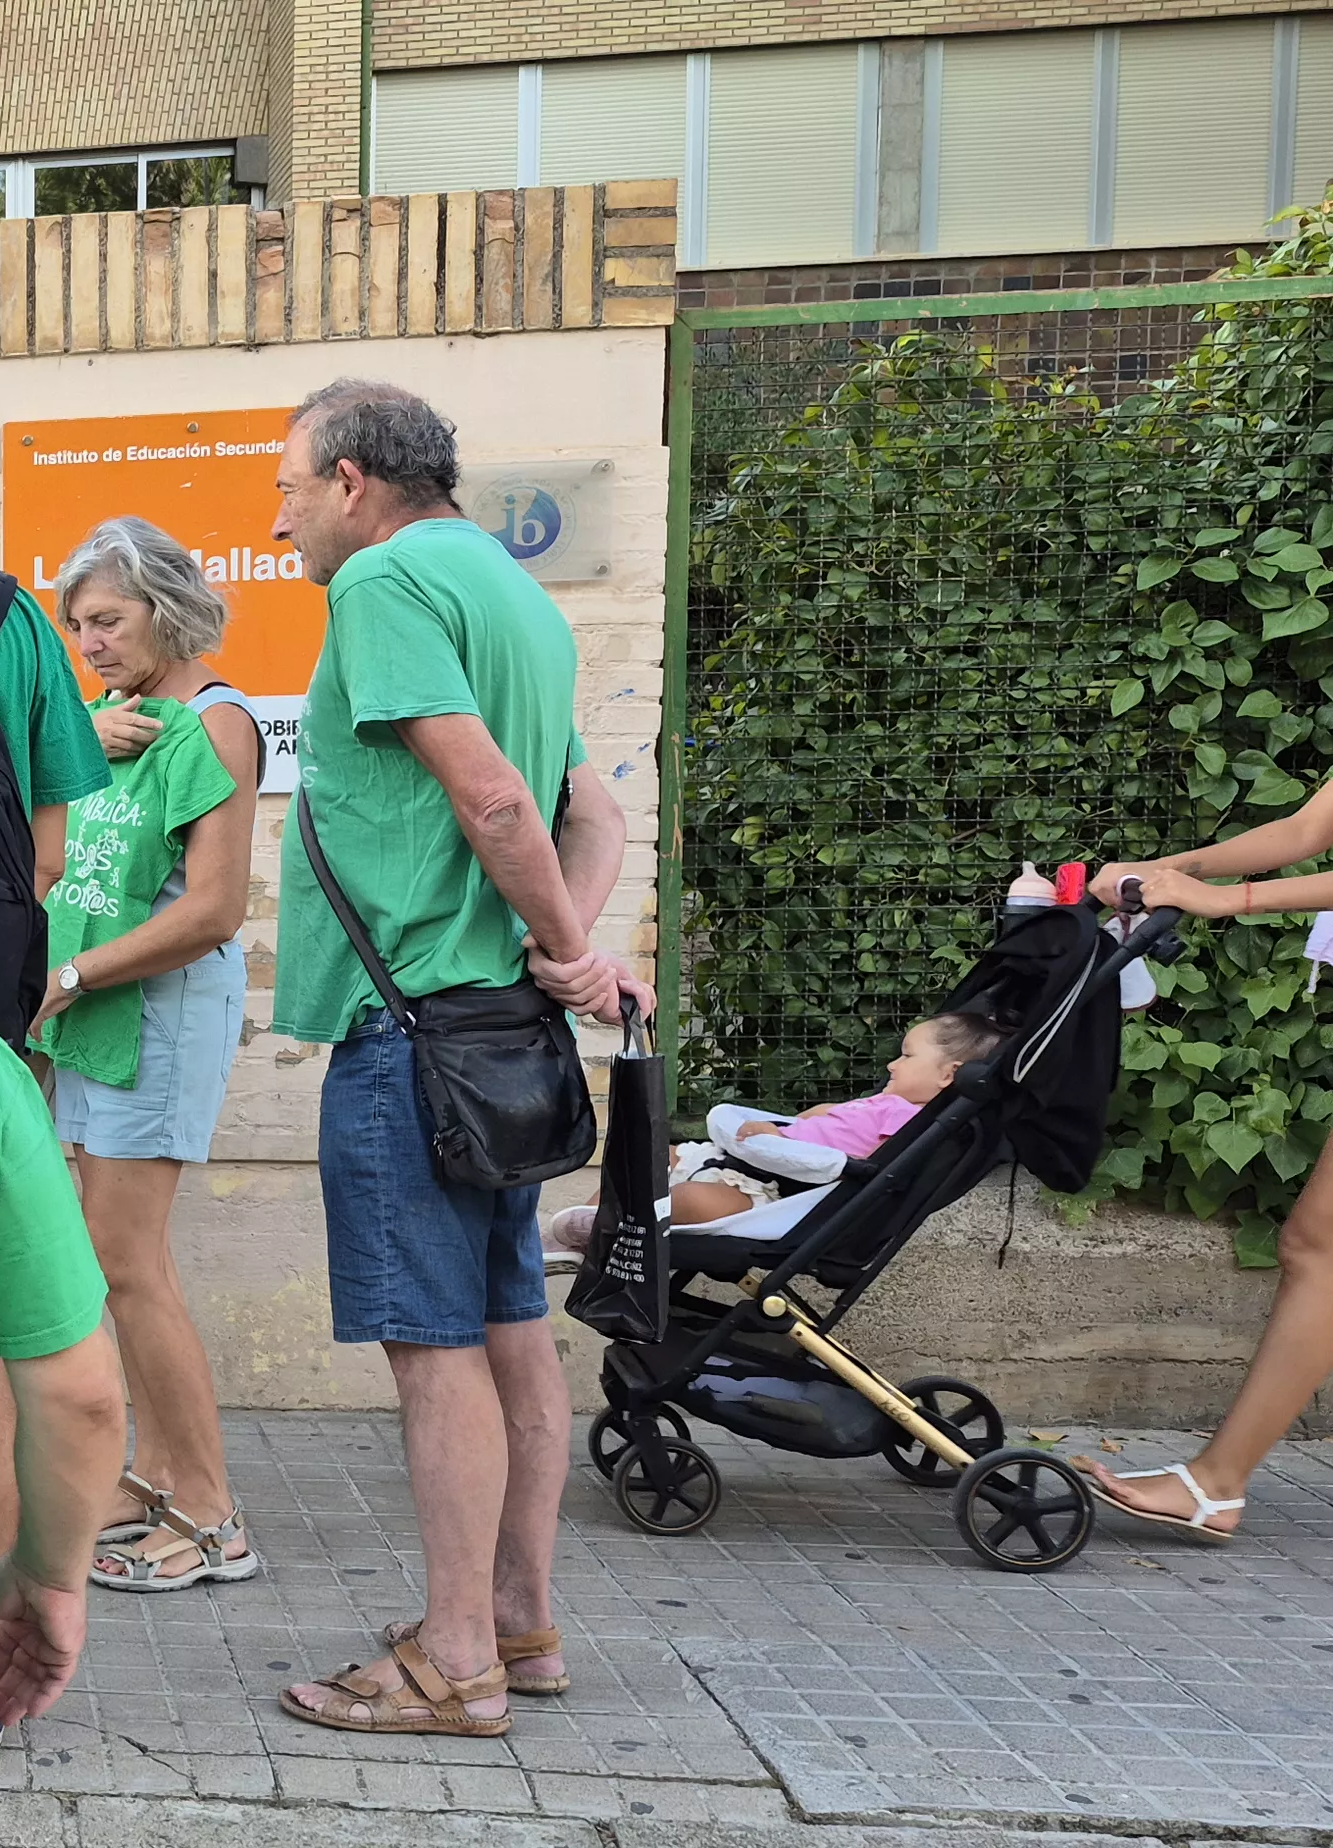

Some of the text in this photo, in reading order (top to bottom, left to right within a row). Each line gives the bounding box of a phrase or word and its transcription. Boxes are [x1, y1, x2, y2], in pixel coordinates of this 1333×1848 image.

[33, 439, 285, 466] Instituto de Educación Secunda
[190, 546, 304, 583] allad
[64, 839, 113, 871] OD@S
